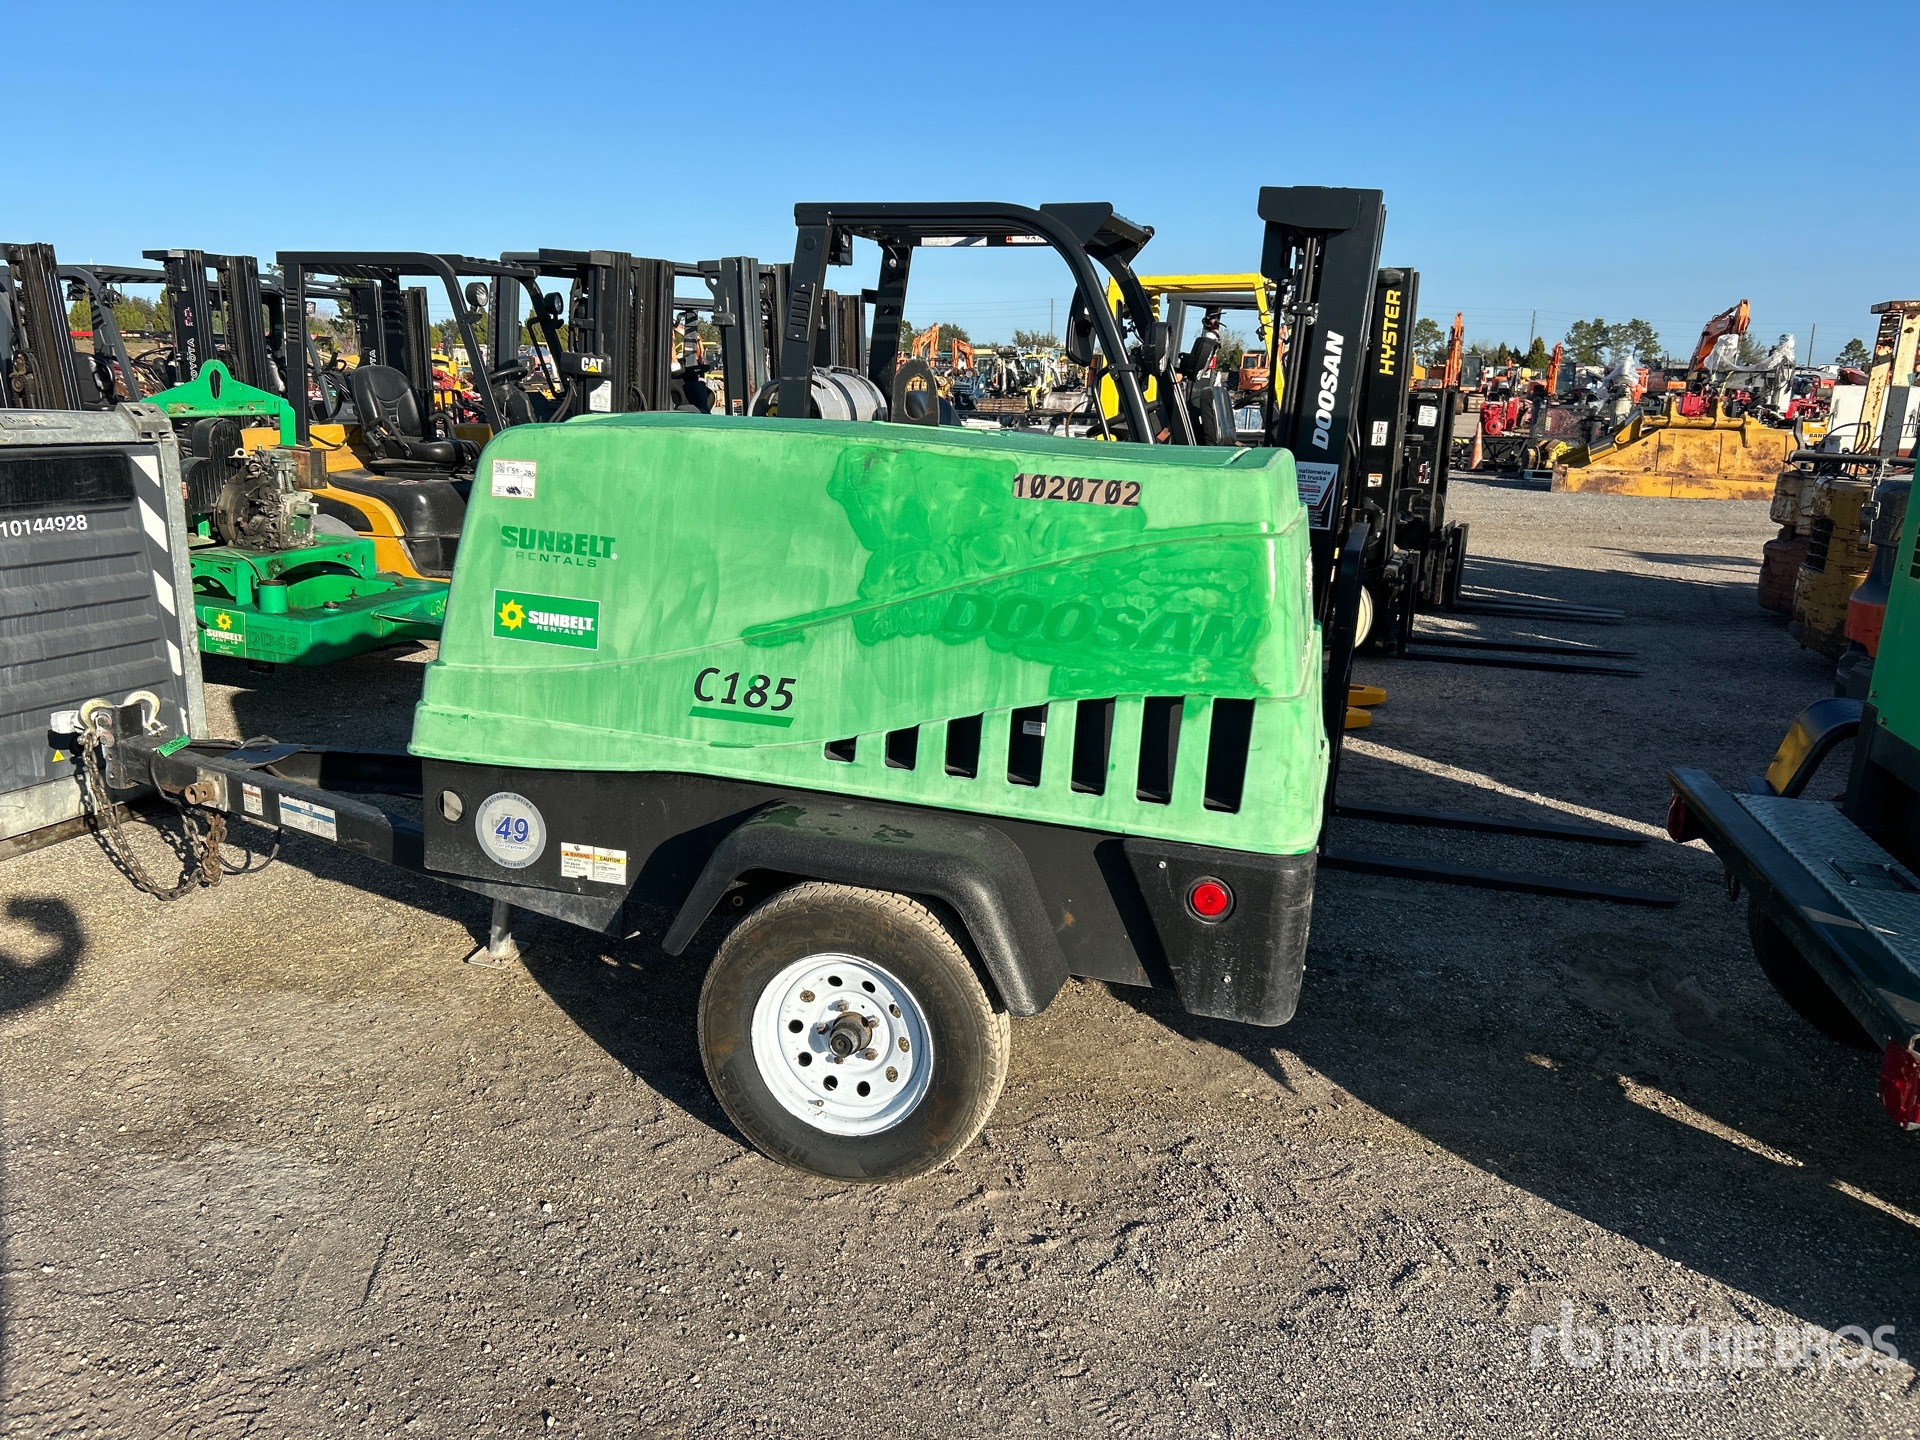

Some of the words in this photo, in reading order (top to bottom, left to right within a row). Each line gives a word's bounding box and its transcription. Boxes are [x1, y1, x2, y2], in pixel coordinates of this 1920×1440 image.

[1379, 289, 1402, 376] HYSTER
[581, 356, 604, 373] CAT
[1312, 330, 1344, 450] DOOSAN
[1298, 468, 1331, 476] nationwide
[1013, 473, 1141, 506] 1020702
[0, 514, 88, 538] 10144928
[501, 525, 616, 559] SUNBELT
[515, 550, 597, 568] RENTALS
[528, 610, 595, 631] SUNBELT
[537, 624, 583, 636] RENTALS
[936, 592, 1262, 658] DOOSAN
[206, 628, 244, 642] SUNBELT
[693, 667, 797, 711] C185
[484, 794, 509, 808] Platinum
[513, 794, 533, 809] Series
[495, 815, 529, 843] 49
[498, 857, 526, 867] Warranty
